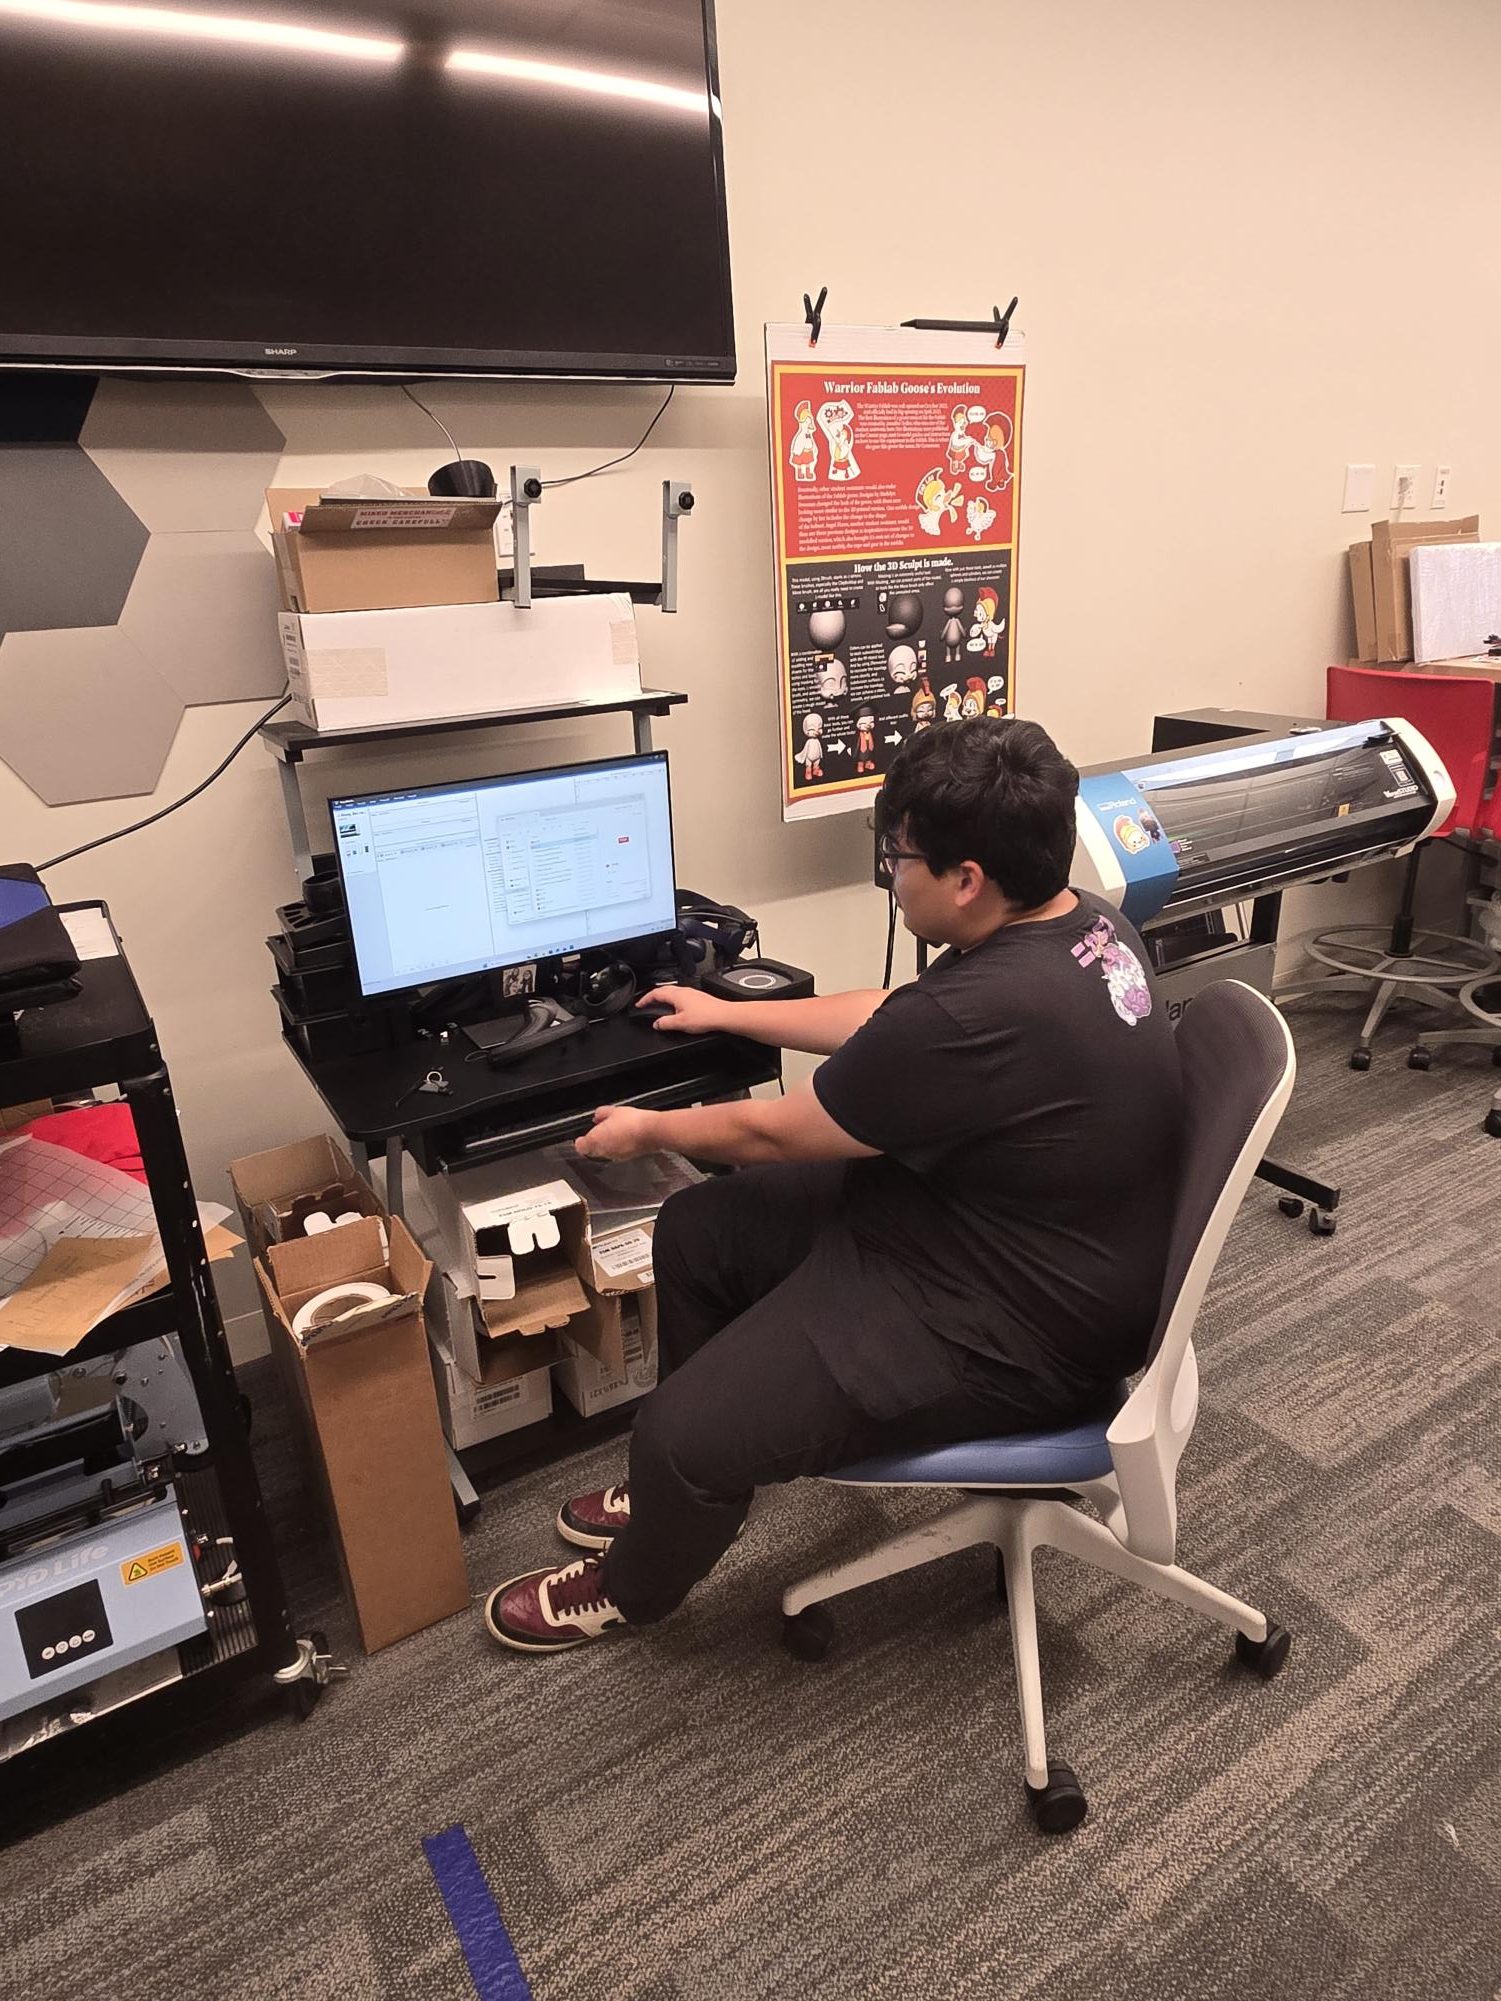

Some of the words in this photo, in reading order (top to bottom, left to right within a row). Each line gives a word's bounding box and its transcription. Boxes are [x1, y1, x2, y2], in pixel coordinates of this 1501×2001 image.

[824, 381, 865, 393] Warrior
[866, 382, 899, 394] Fablab
[901, 381, 936, 394] Goose's
[937, 382, 980, 394] Evolution
[854, 564, 872, 573] How
[874, 562, 886, 572] the
[888, 561, 898, 570] 3D
[899, 560, 922, 570] Sculpt
[923, 559, 930, 568] is
[931, 557, 954, 567] made.
[53, 1544, 109, 1576] Life
